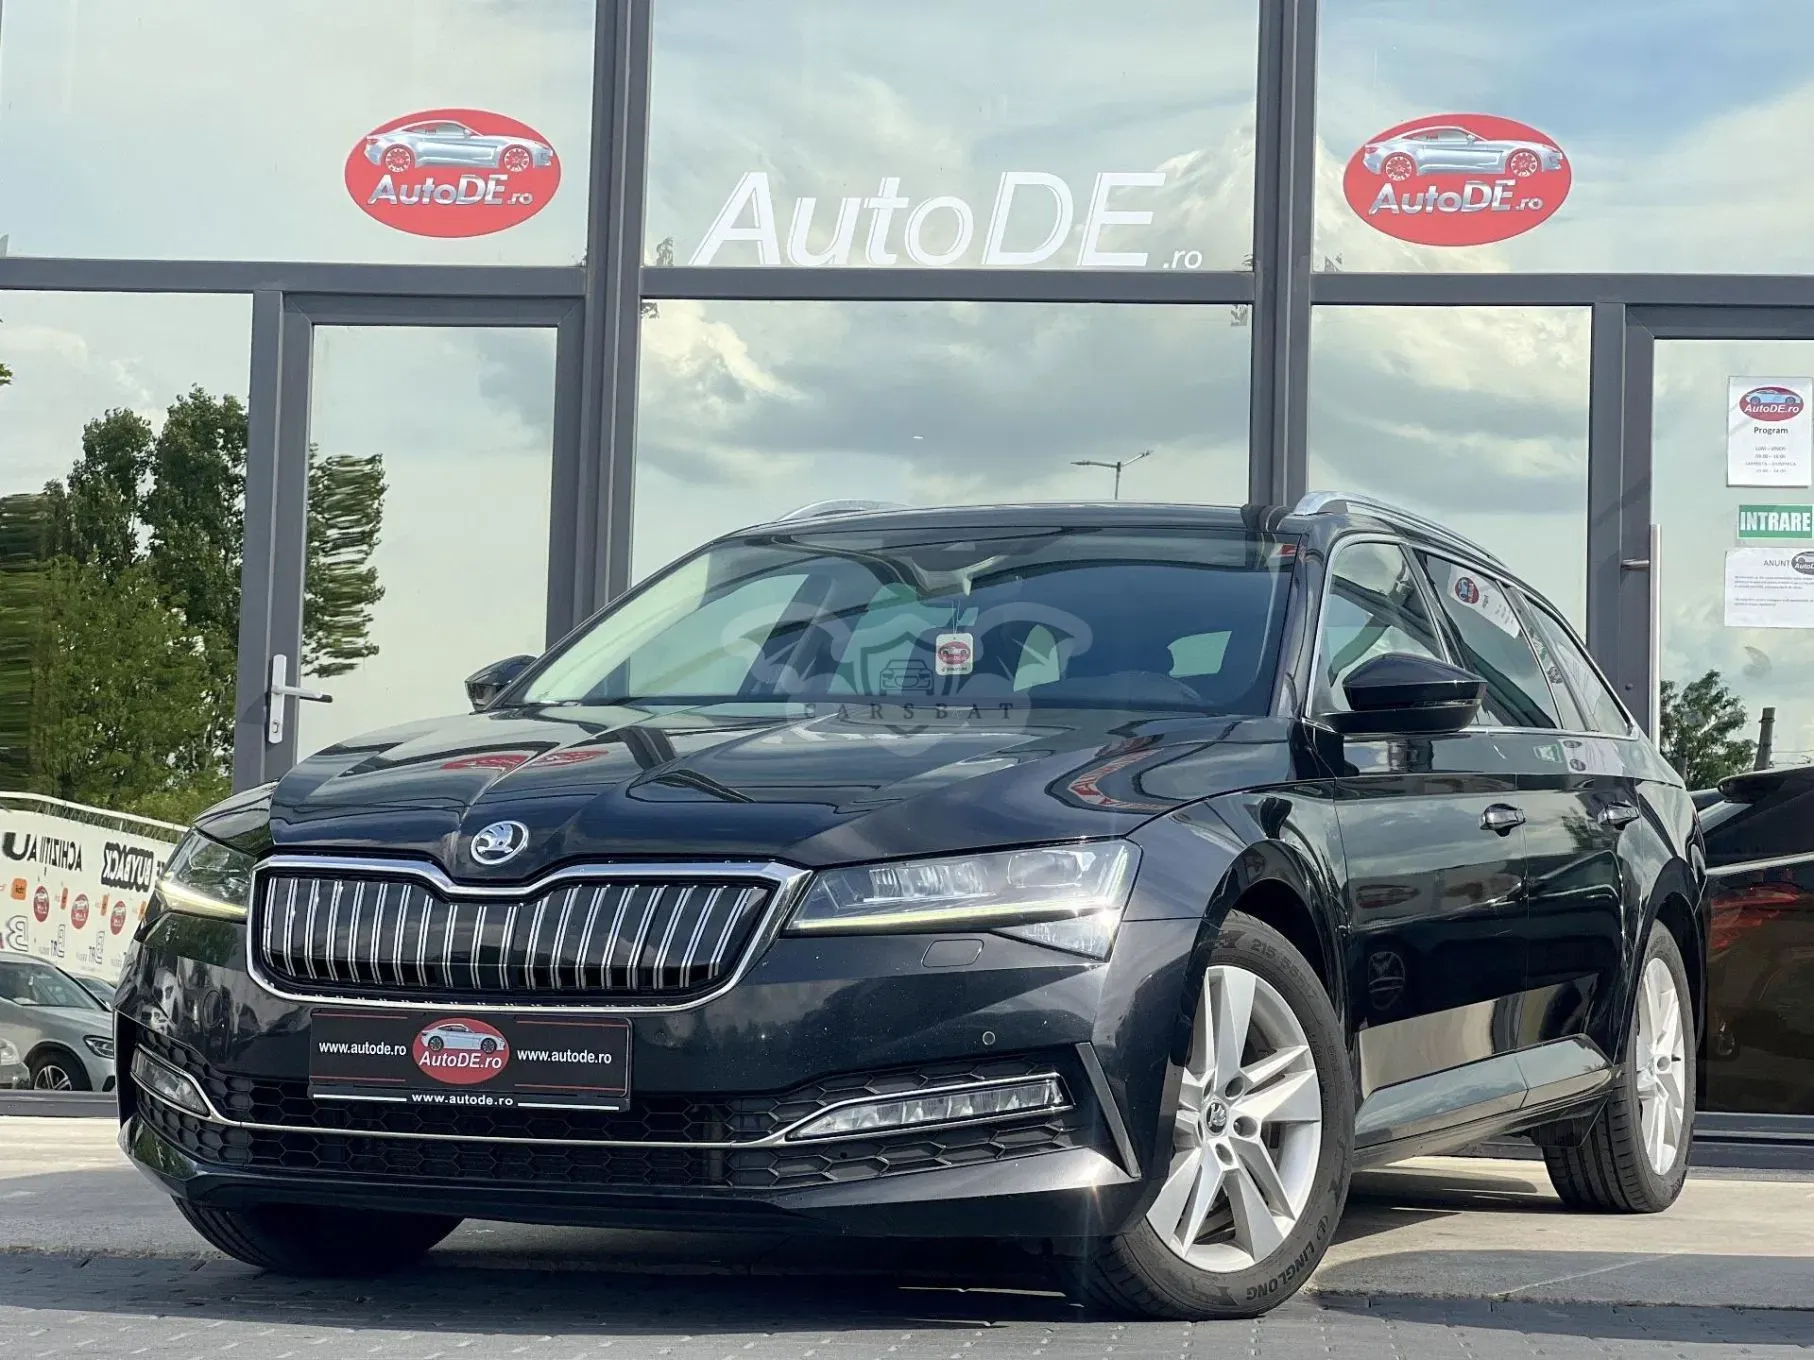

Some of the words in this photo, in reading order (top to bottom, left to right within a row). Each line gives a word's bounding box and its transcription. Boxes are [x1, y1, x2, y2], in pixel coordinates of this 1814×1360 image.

[1753, 426, 1789, 435] Program
[1740, 511, 1811, 532] INTRARE
[318, 1041, 407, 1056] www.autode.ro
[516, 1048, 612, 1065] www.autode.ro
[418, 1052, 502, 1069] AutoDE.ro
[411, 1093, 514, 1107] www.autode.ro
[1246, 1241, 1315, 1300] LINGLONG
